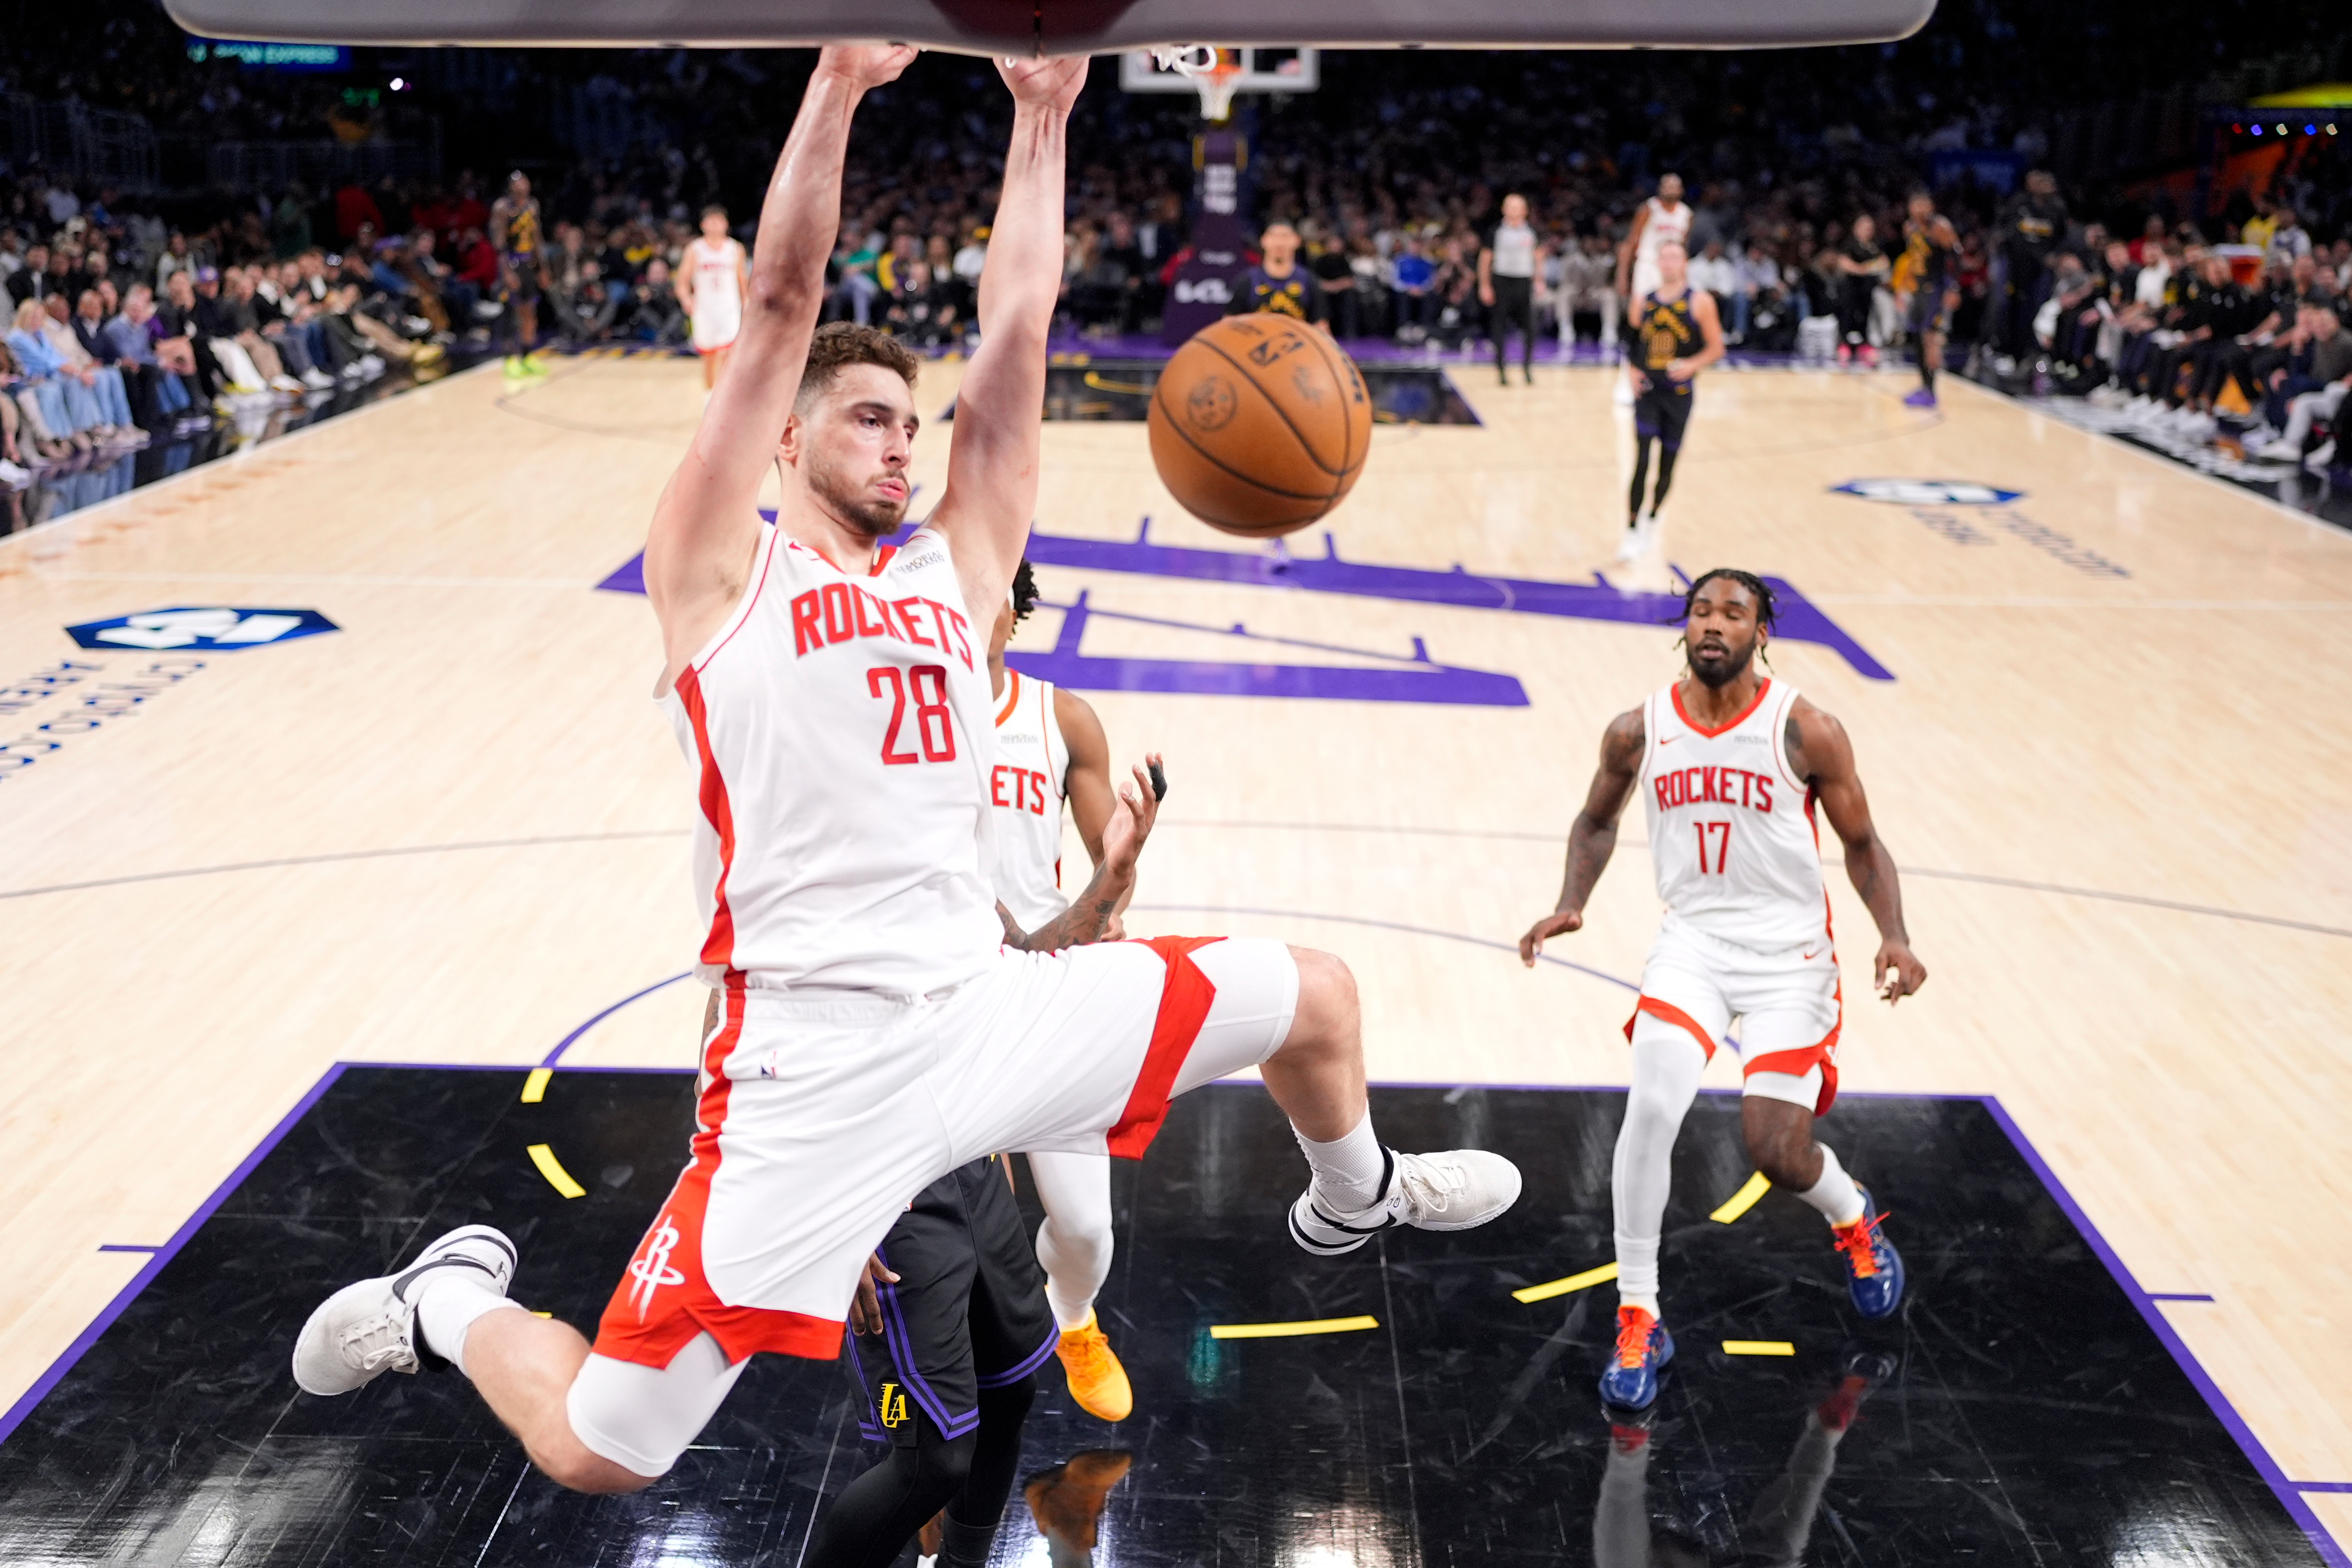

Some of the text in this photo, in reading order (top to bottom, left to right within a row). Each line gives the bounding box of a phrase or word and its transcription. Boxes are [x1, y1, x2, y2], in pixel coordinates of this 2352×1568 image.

[791, 582, 974, 673] ROCKETS
[866, 665, 956, 766] 28
[1654, 766, 1774, 813] ROCKETS
[1694, 822, 1731, 874] 17
[879, 1383, 911, 1429] LA
